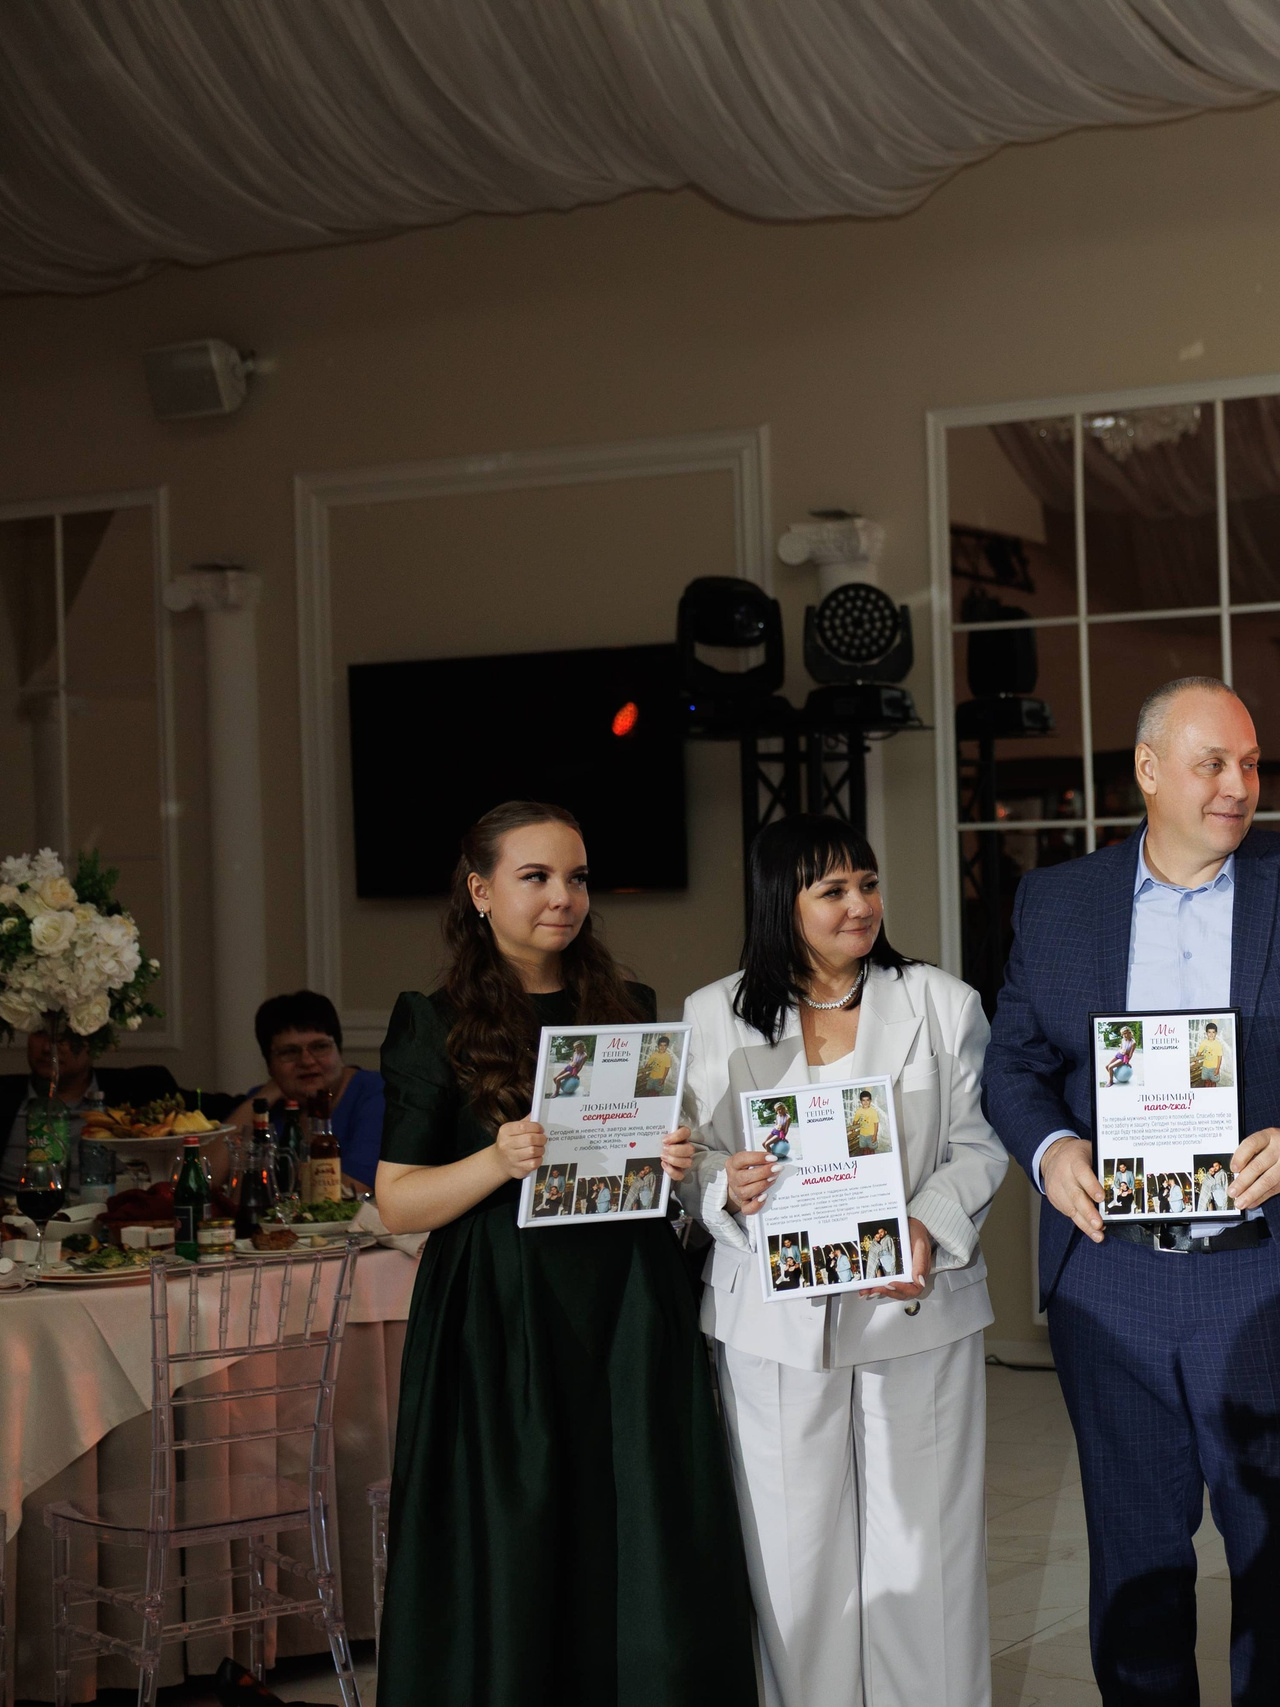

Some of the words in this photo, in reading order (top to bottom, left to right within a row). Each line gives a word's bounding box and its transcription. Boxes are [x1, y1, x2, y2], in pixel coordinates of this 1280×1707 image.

[1154, 1024, 1176, 1036] Мы
[606, 1037, 629, 1050] Мы
[602, 1050, 631, 1058] ТЕПЕРЬ
[809, 1096, 830, 1109] Мы
[1137, 1091, 1195, 1102] ЛЮБИМЫЙ
[580, 1101, 638, 1112] ЛЮБИМЫЙ
[1144, 1099, 1192, 1111] папочка!
[582, 1108, 639, 1125] сестренка!
[805, 1109, 835, 1118] ТЕПЕРЬ
[796, 1160, 858, 1176] ЛЮБИМАЯ
[802, 1168, 857, 1186] мамочка!
